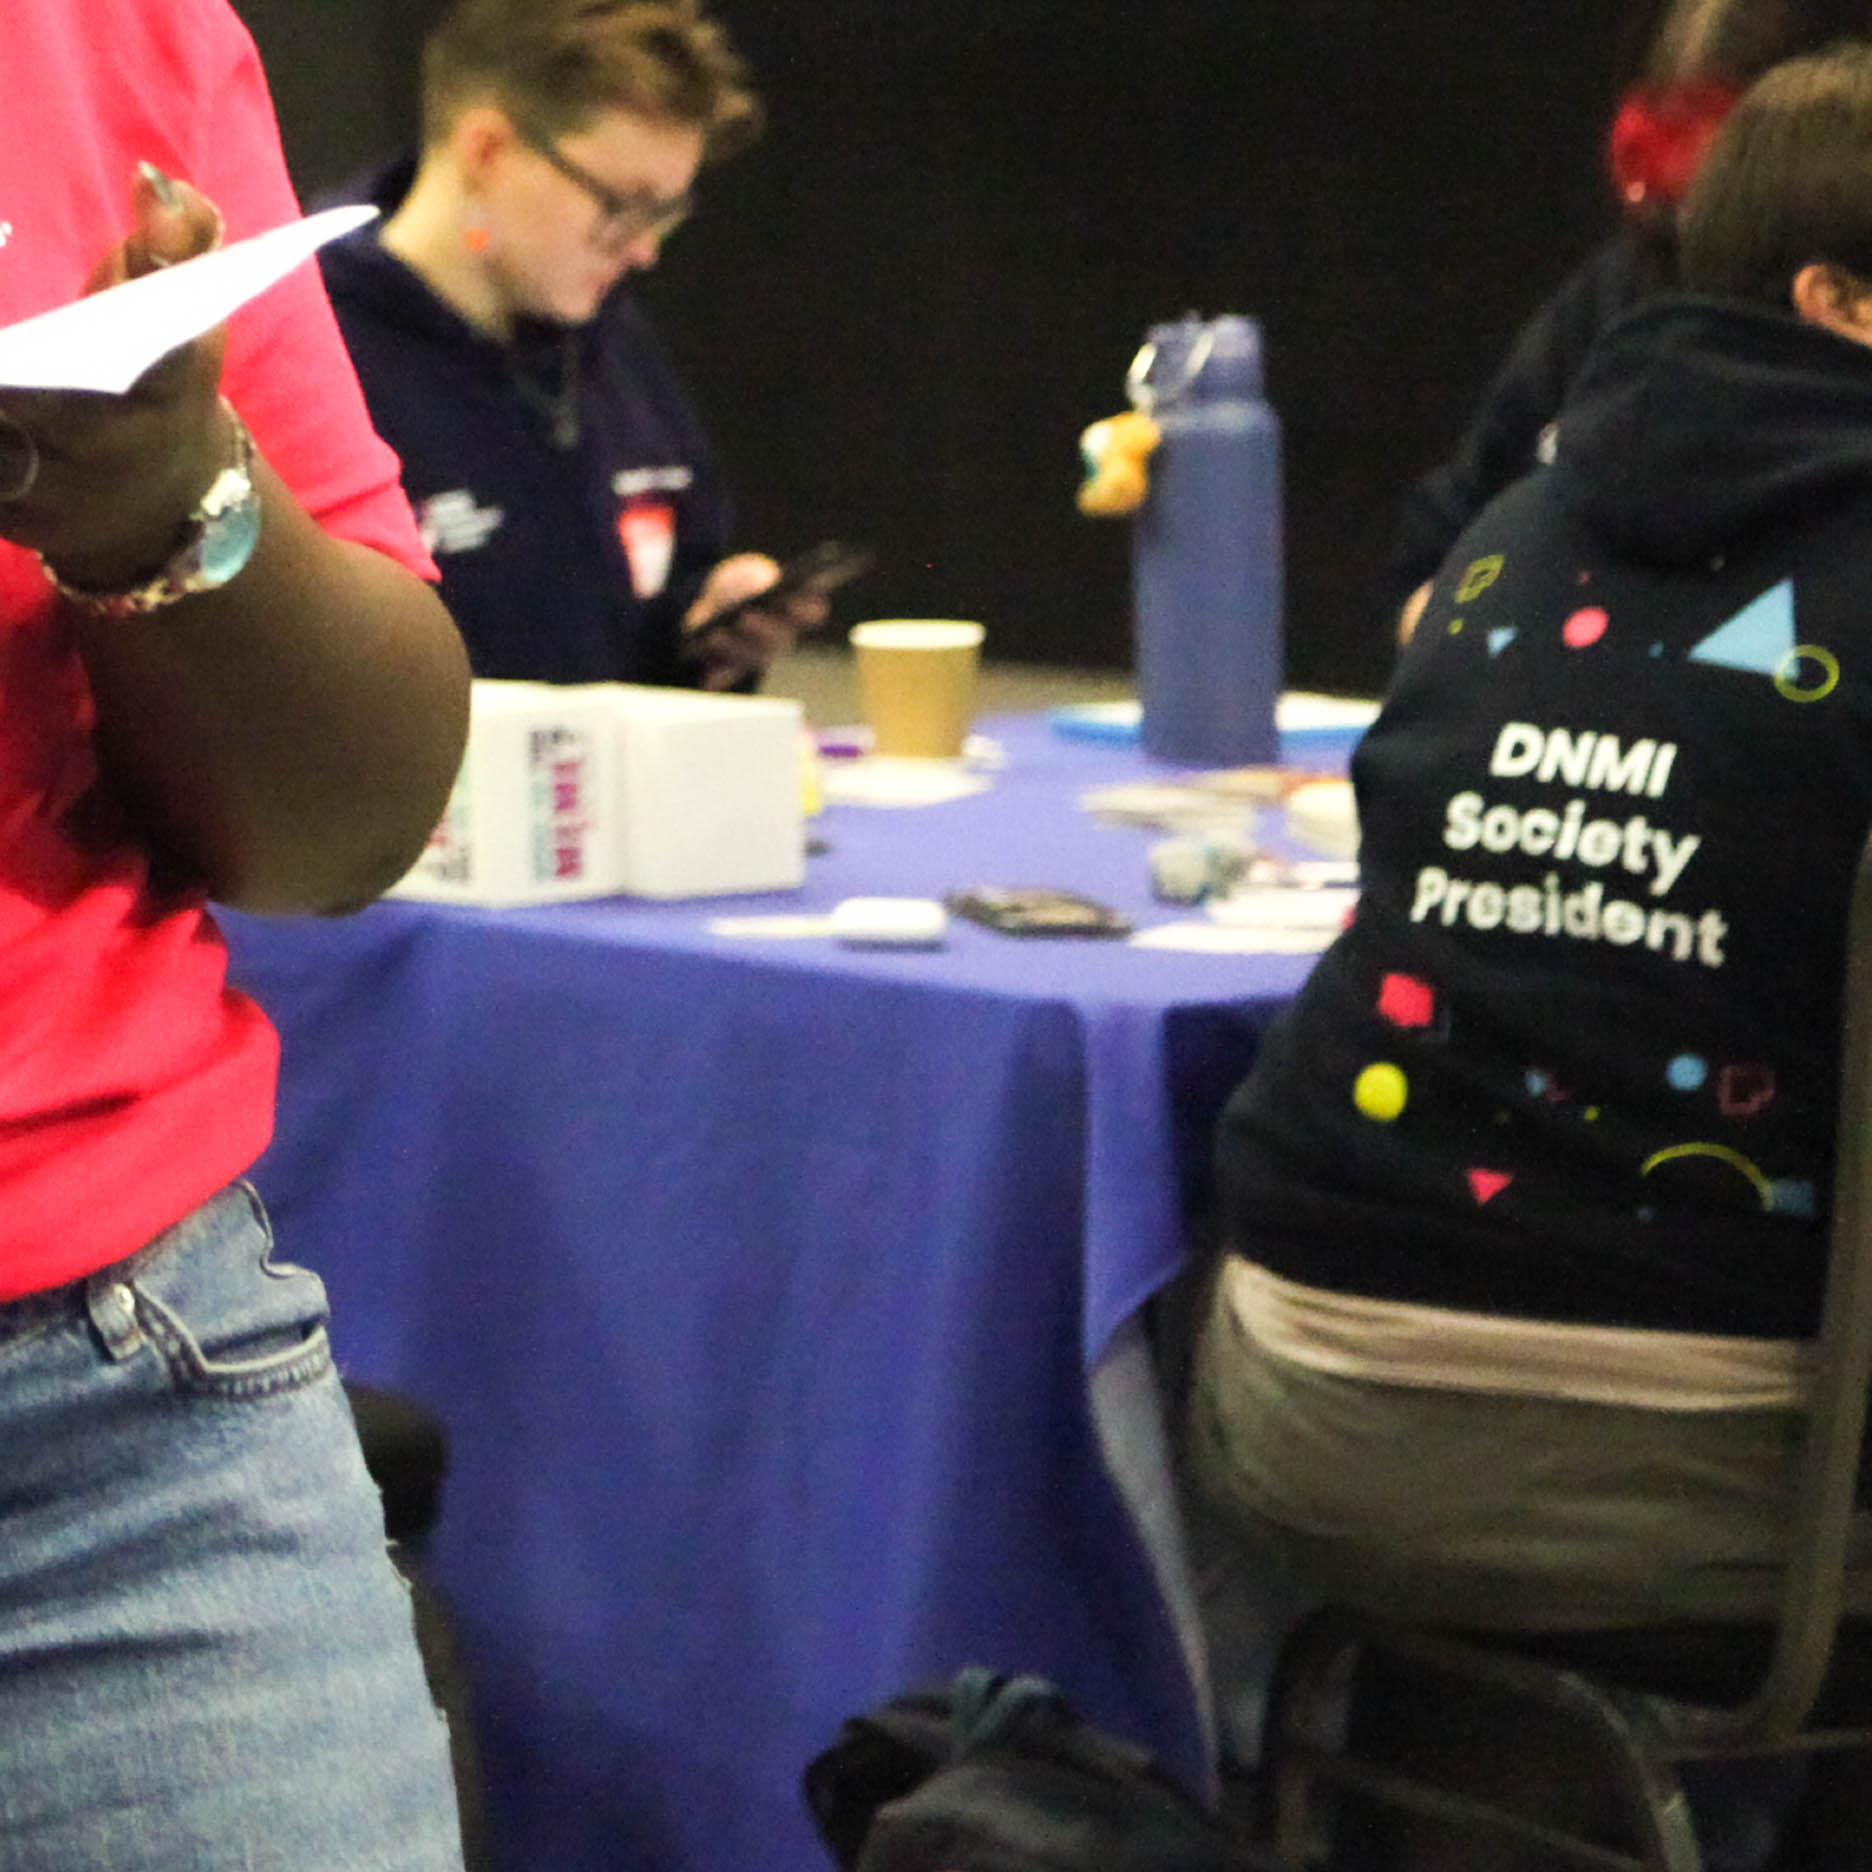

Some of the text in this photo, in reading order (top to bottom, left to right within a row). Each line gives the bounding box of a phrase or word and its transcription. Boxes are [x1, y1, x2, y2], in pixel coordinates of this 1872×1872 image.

[1490, 722, 1678, 799] DNMI
[1444, 792, 1703, 895] Society
[1410, 866, 1729, 968] President
